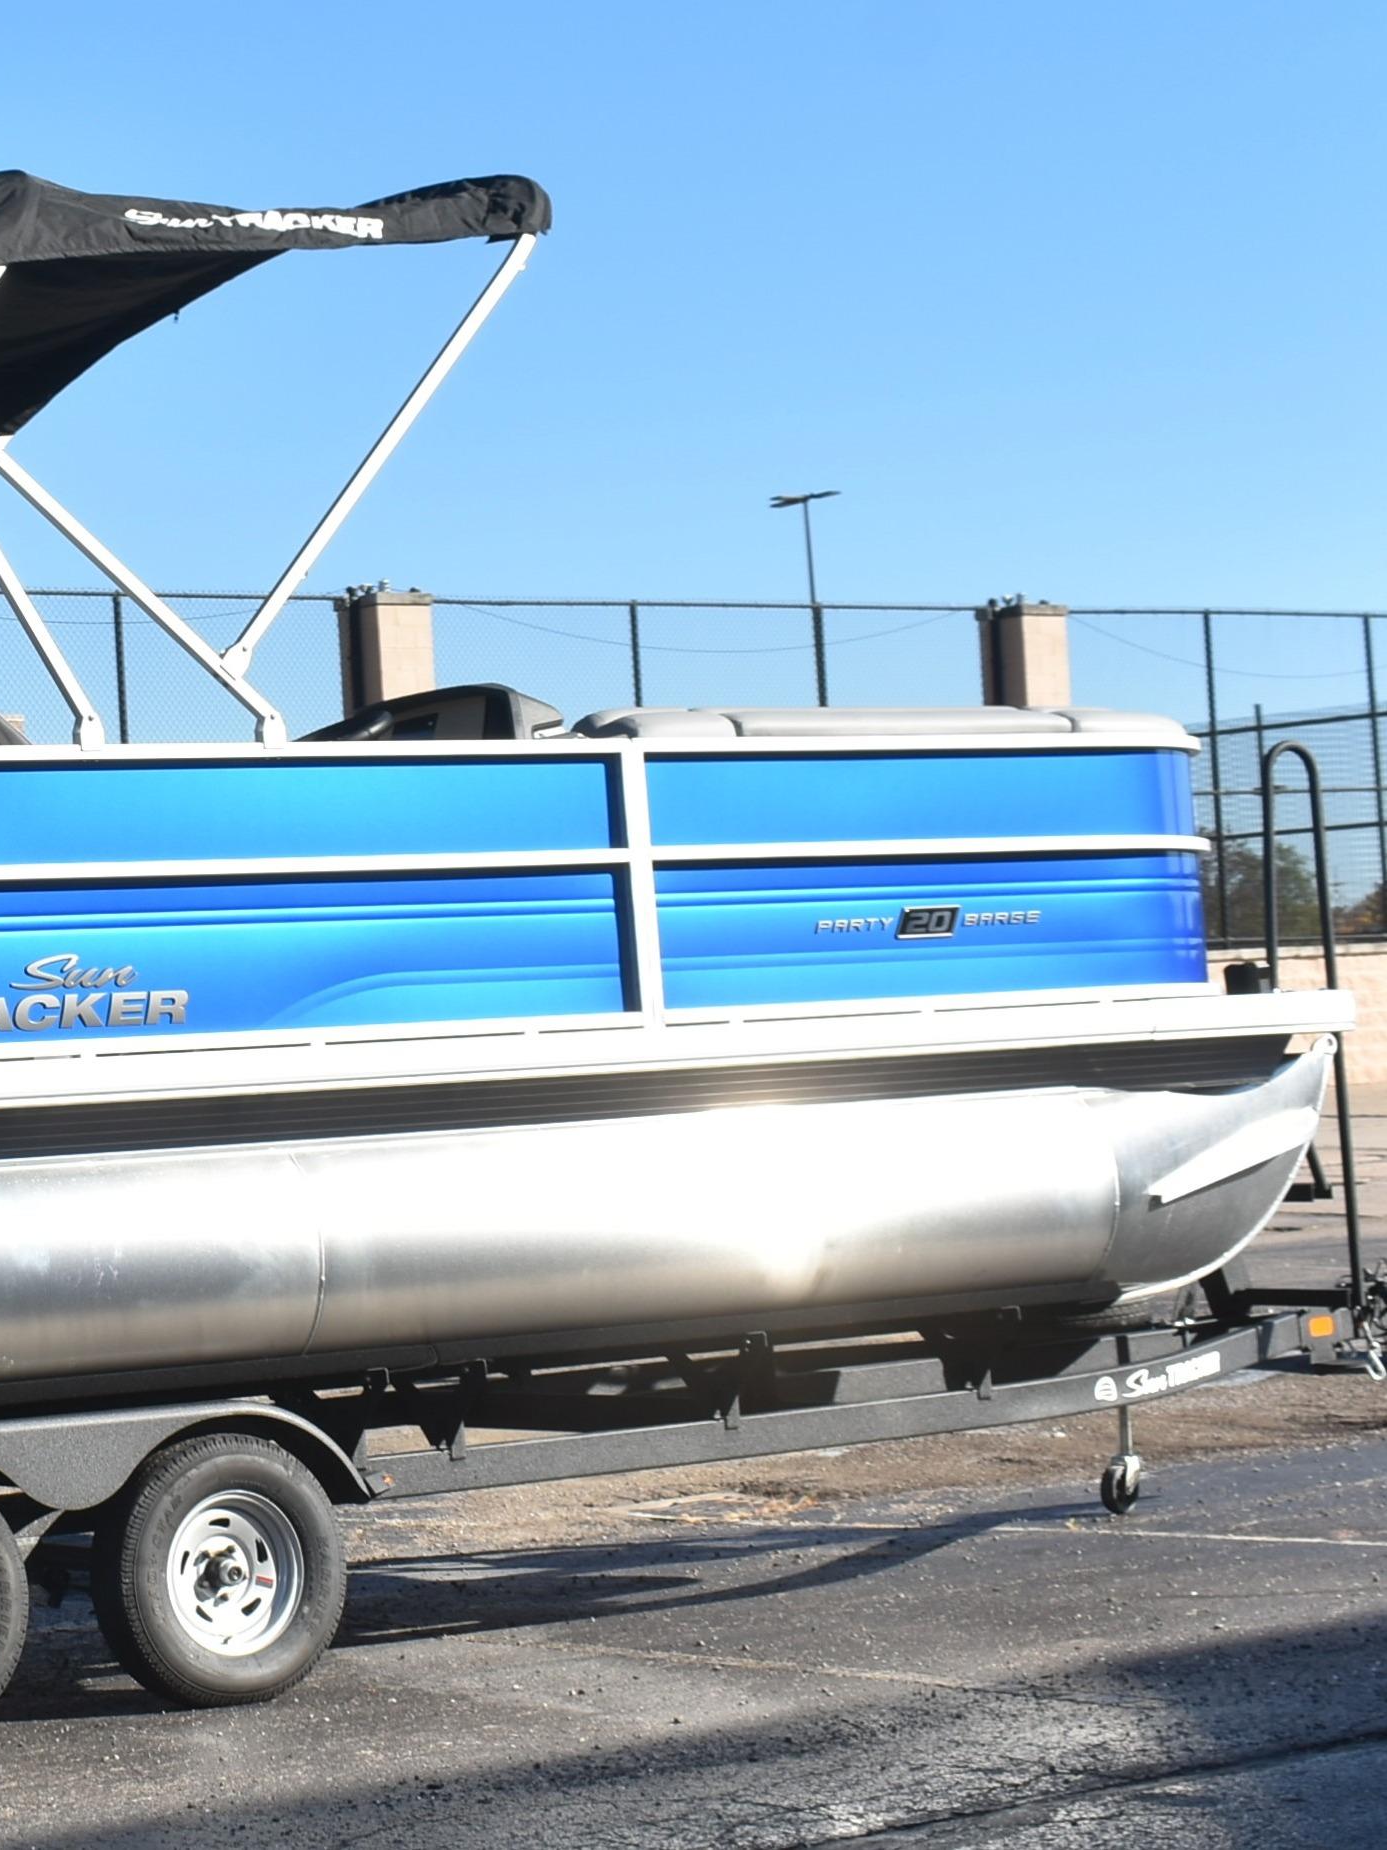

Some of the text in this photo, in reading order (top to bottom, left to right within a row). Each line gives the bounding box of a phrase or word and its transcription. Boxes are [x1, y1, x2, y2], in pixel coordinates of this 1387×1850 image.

[123, 208, 384, 239] Sun TRACKER
[815, 909, 1042, 935] PARTY 20 BARGE
[9, 952, 139, 992] Sun
